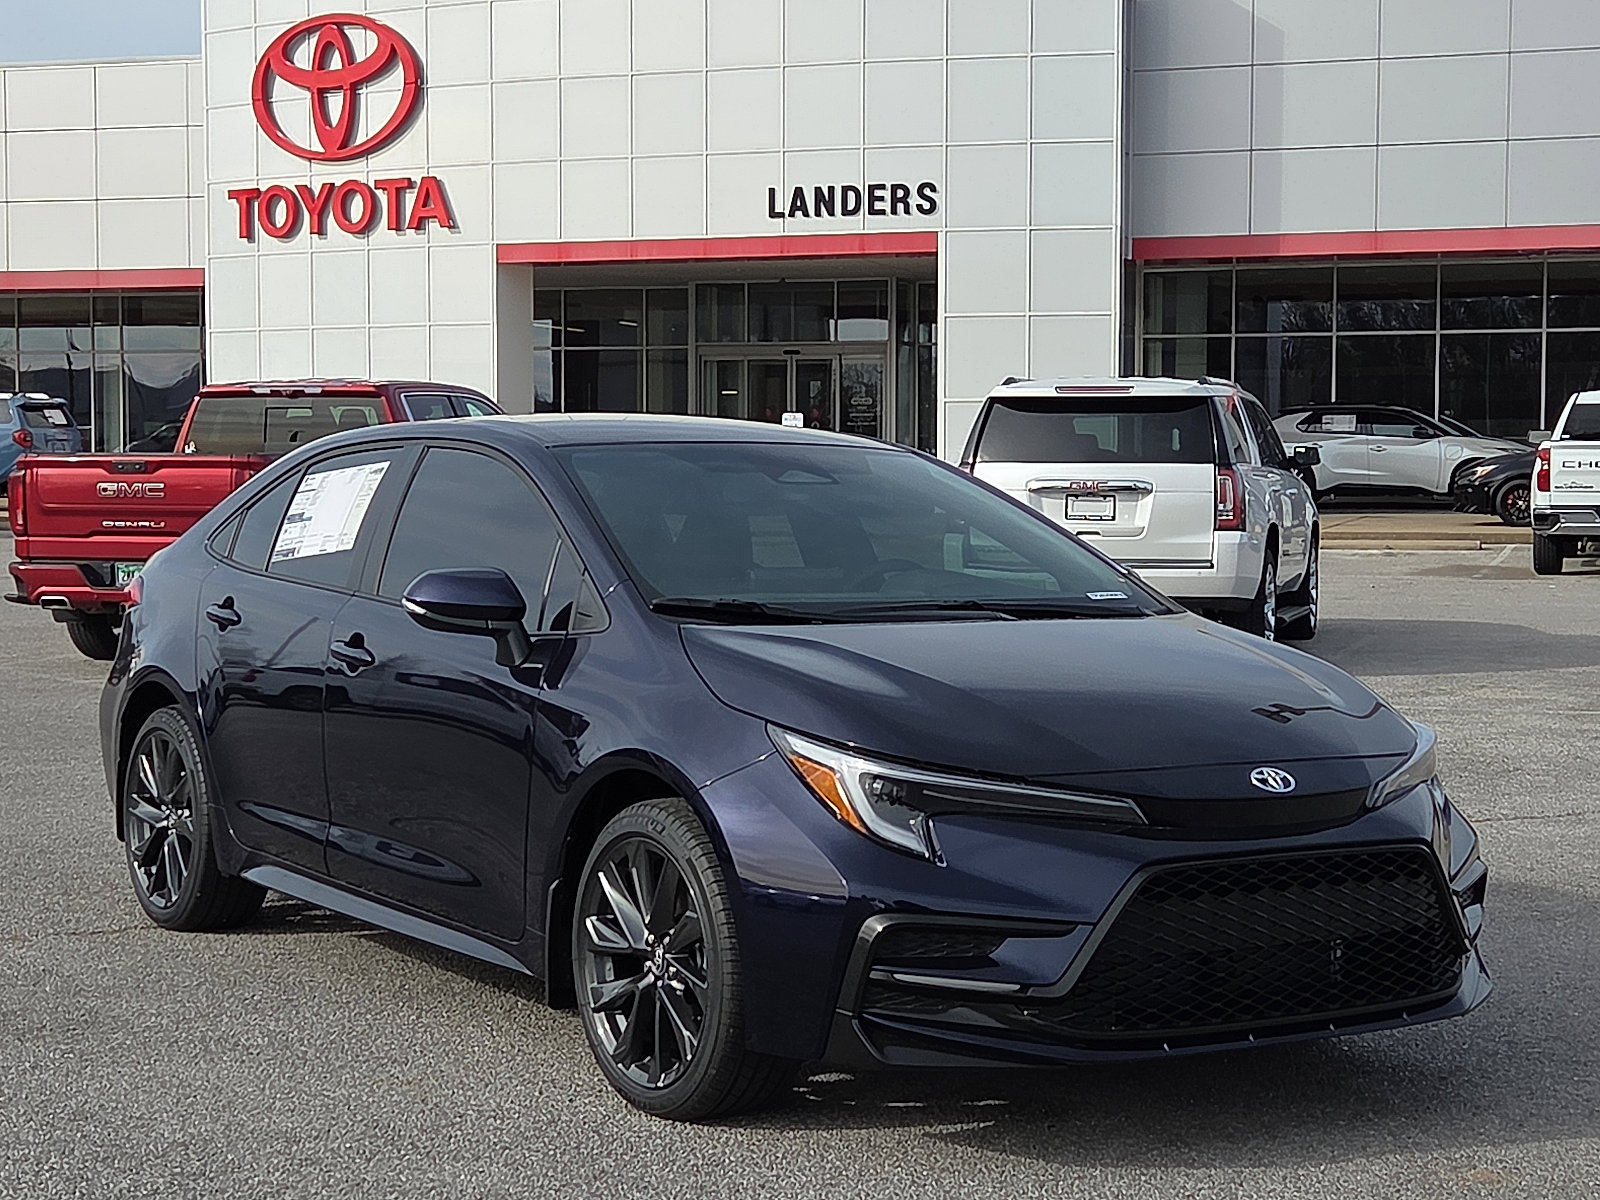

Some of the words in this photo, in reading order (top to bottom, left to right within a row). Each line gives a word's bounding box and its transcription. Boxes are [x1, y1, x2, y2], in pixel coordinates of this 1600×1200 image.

[228, 176, 454, 239] TOYOTA
[768, 182, 938, 218] LANDERS
[97, 482, 165, 498] GMC
[1069, 480, 1109, 491] GMC
